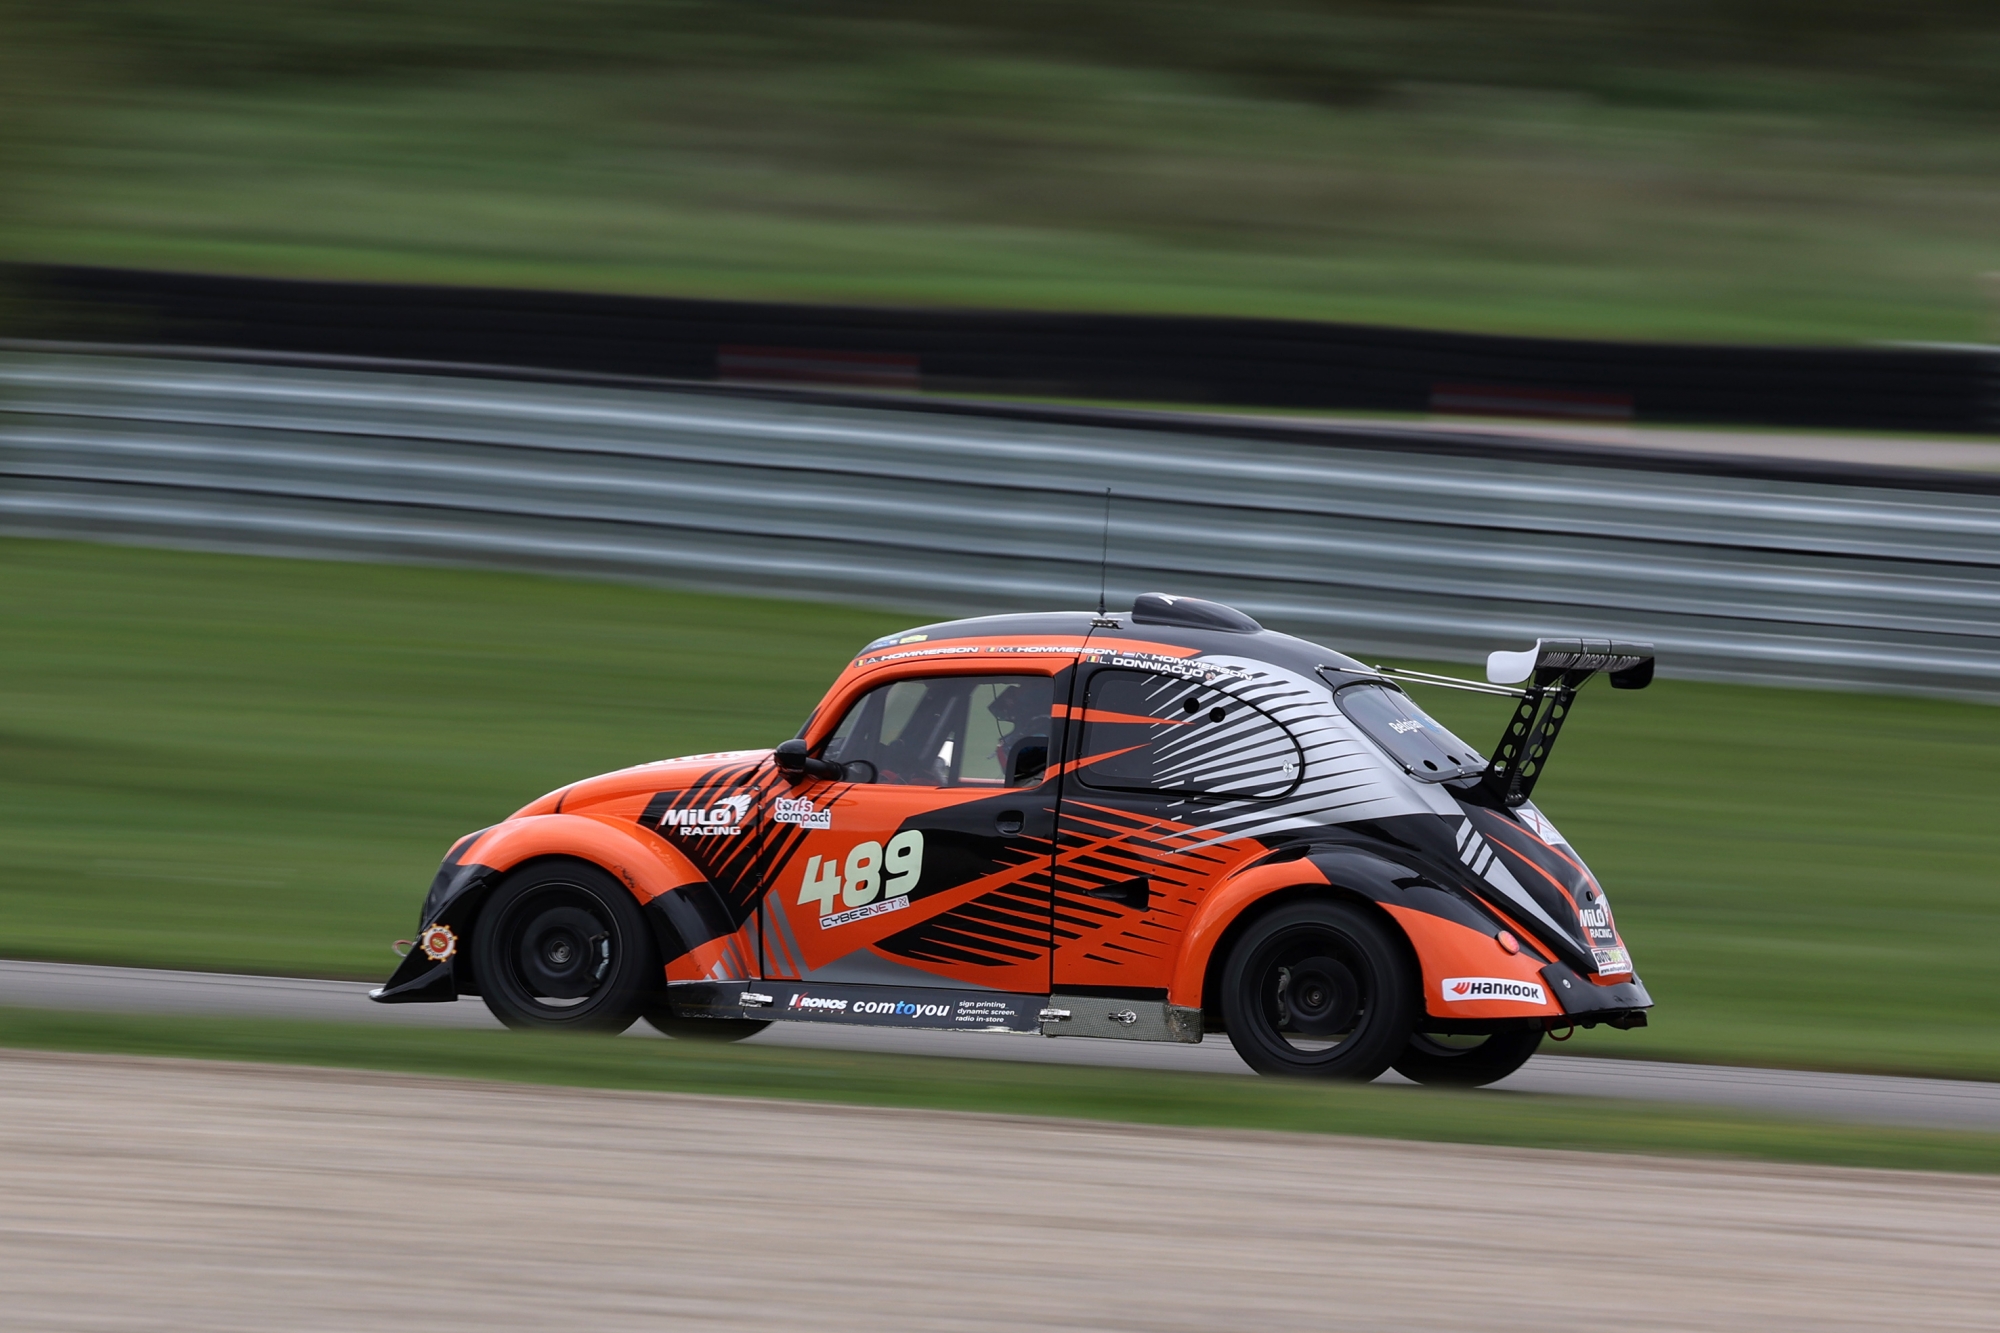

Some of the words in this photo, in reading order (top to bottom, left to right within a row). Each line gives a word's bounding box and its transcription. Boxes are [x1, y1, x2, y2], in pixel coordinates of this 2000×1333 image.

[866, 657, 878, 665] A.
[881, 647, 979, 661] HOMMERSON
[1016, 647, 1118, 656] HOMMERSON
[1099, 656, 1111, 665] L.
[1135, 652, 1149, 660] N.
[1151, 654, 1254, 681] HOMMERSON
[775, 811, 830, 827] compact
[680, 826, 742, 836] RACING
[797, 829, 925, 917] 489
[1589, 928, 1613, 939] RACING
[958, 1000, 975, 1008] sign
[852, 1001, 950, 1019] comtoyou
[956, 1008, 990, 1016] dynamic
